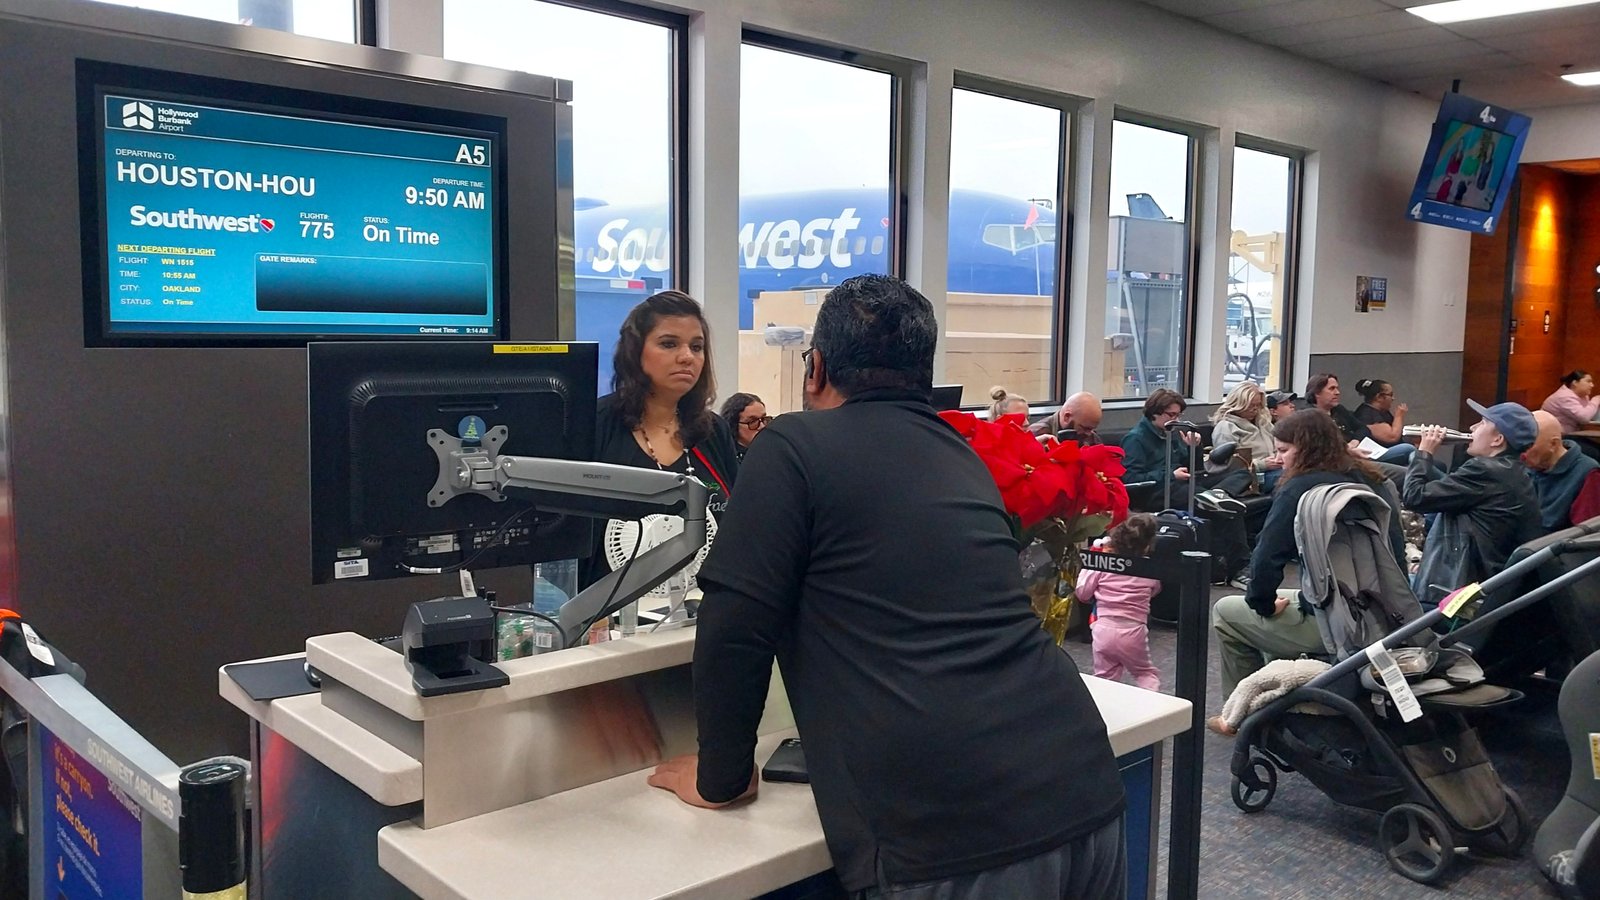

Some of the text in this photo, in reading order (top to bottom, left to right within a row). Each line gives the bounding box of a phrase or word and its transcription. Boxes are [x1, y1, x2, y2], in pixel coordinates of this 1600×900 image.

[158, 107, 199, 119] Hollywood
[158, 115, 192, 126] Burbank
[158, 123, 184, 132] Airport
[115, 148, 177, 161] DEPARTING TO:
[455, 143, 486, 165] A5
[117, 160, 316, 198] HOUSTON-HOU
[432, 177, 486, 189] DEPARTURE TIME:
[405, 186, 485, 210] 9:50 AM
[299, 212, 330, 220] FLIGHT#:
[363, 216, 390, 225] STATUS:
[299, 220, 335, 240] 775
[363, 224, 440, 246] On Time
[117, 244, 217, 257] NEXT DEPARTING FLIGHT
[161, 258, 175, 266] WN
[259, 255, 318, 265] GATE REMARKS:
[119, 270, 141, 278] TIME:
[183, 272, 197, 280] AM
[119, 284, 201, 293] CITY: OAKLAND
[120, 298, 153, 306] STATUS:
[162, 298, 175, 306] On
[419, 326, 443, 334] Current
[87, 738, 135, 788] SOUTHWEST
[134, 774, 174, 820] AIRLINES
[56, 792, 75, 826] please
[74, 814, 93, 849] check
